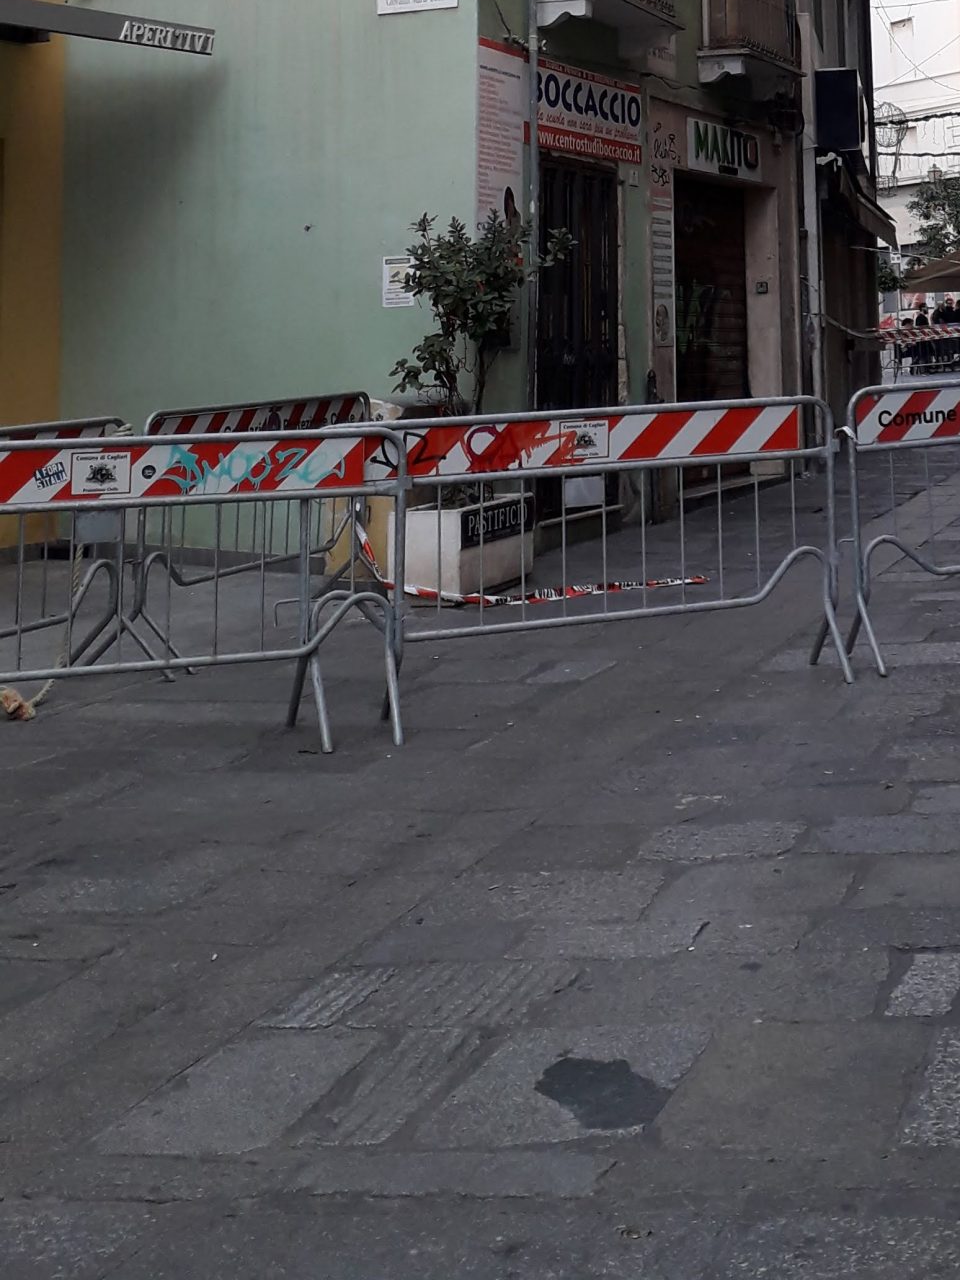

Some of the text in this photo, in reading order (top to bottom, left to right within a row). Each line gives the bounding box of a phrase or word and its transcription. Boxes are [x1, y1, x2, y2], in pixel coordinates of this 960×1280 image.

[118, 20, 215, 54] APERITIVI
[877, 405, 958, 428] Comune
[76, 455, 99, 463] Comune
[106, 453, 129, 461] Cagliari
